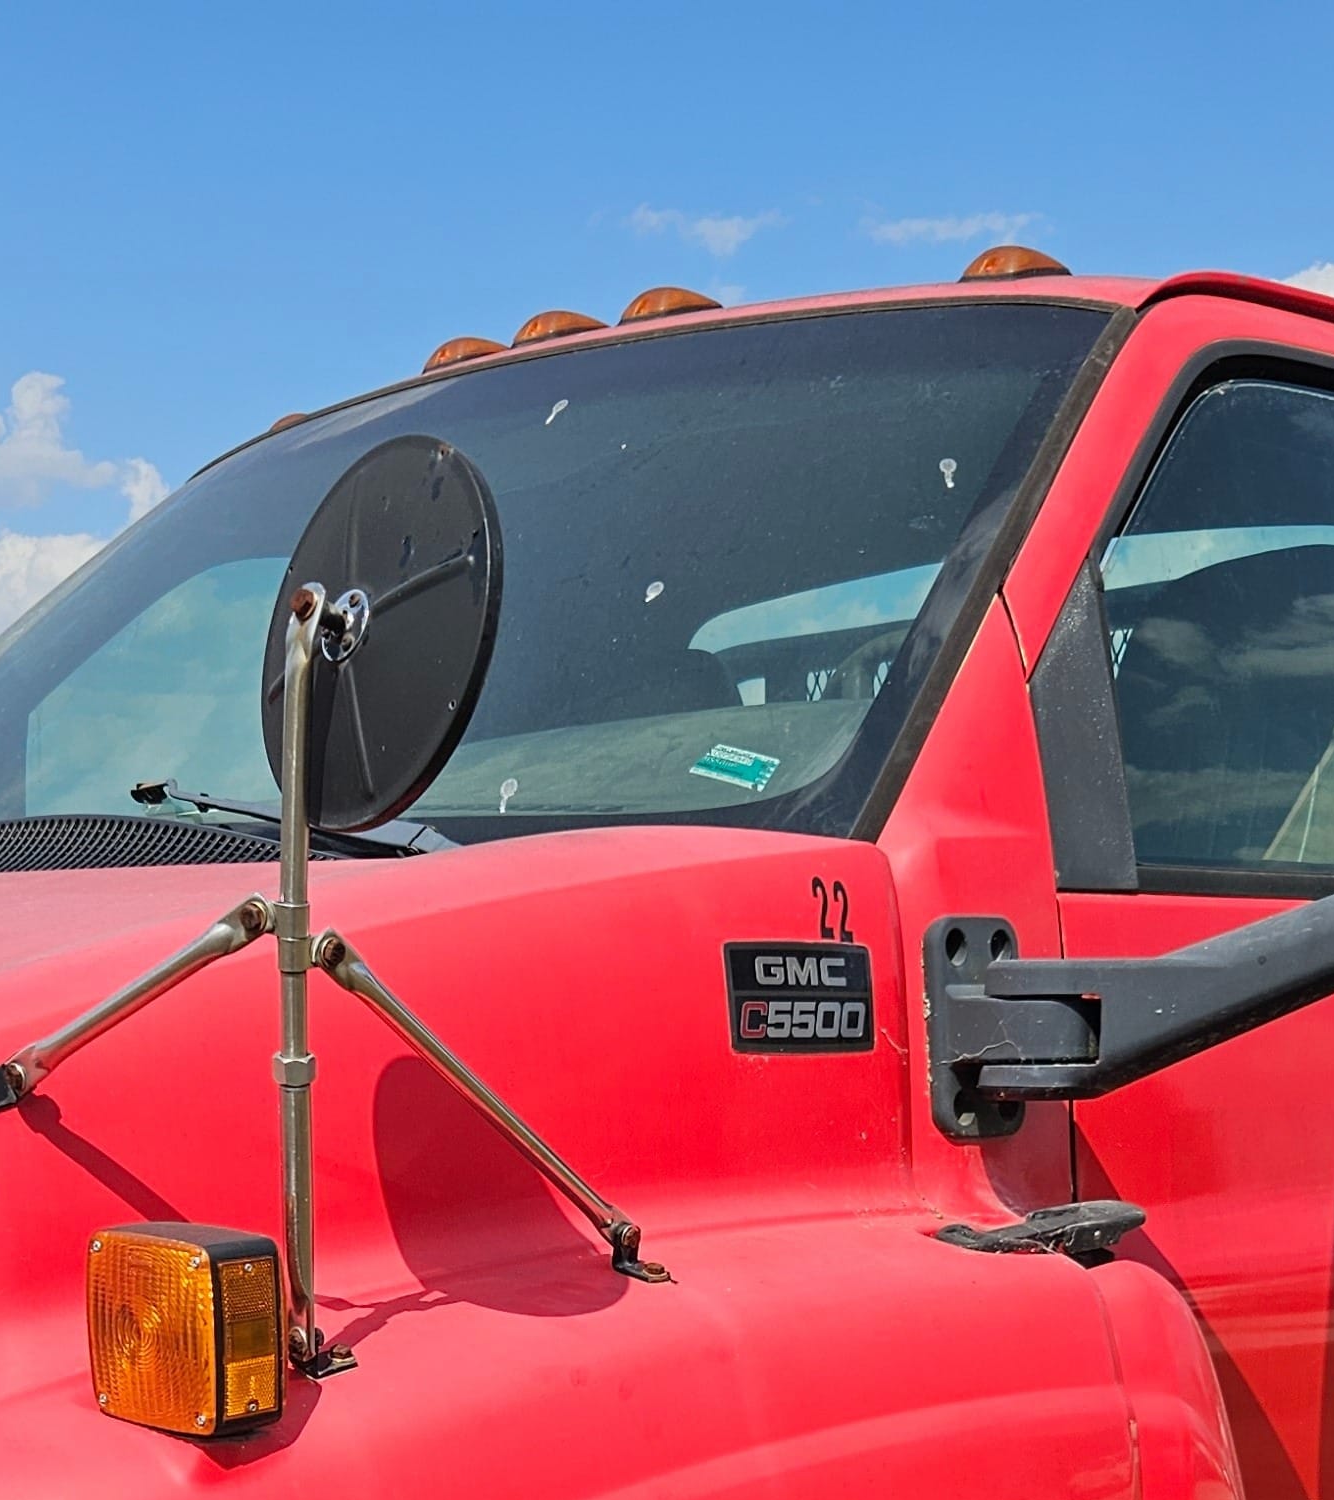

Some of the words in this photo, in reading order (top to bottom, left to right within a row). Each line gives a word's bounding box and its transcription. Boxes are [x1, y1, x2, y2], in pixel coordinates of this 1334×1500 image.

[811, 876, 854, 943] 22
[754, 956, 847, 987] GMC
[740, 1001, 866, 1039] C5500
